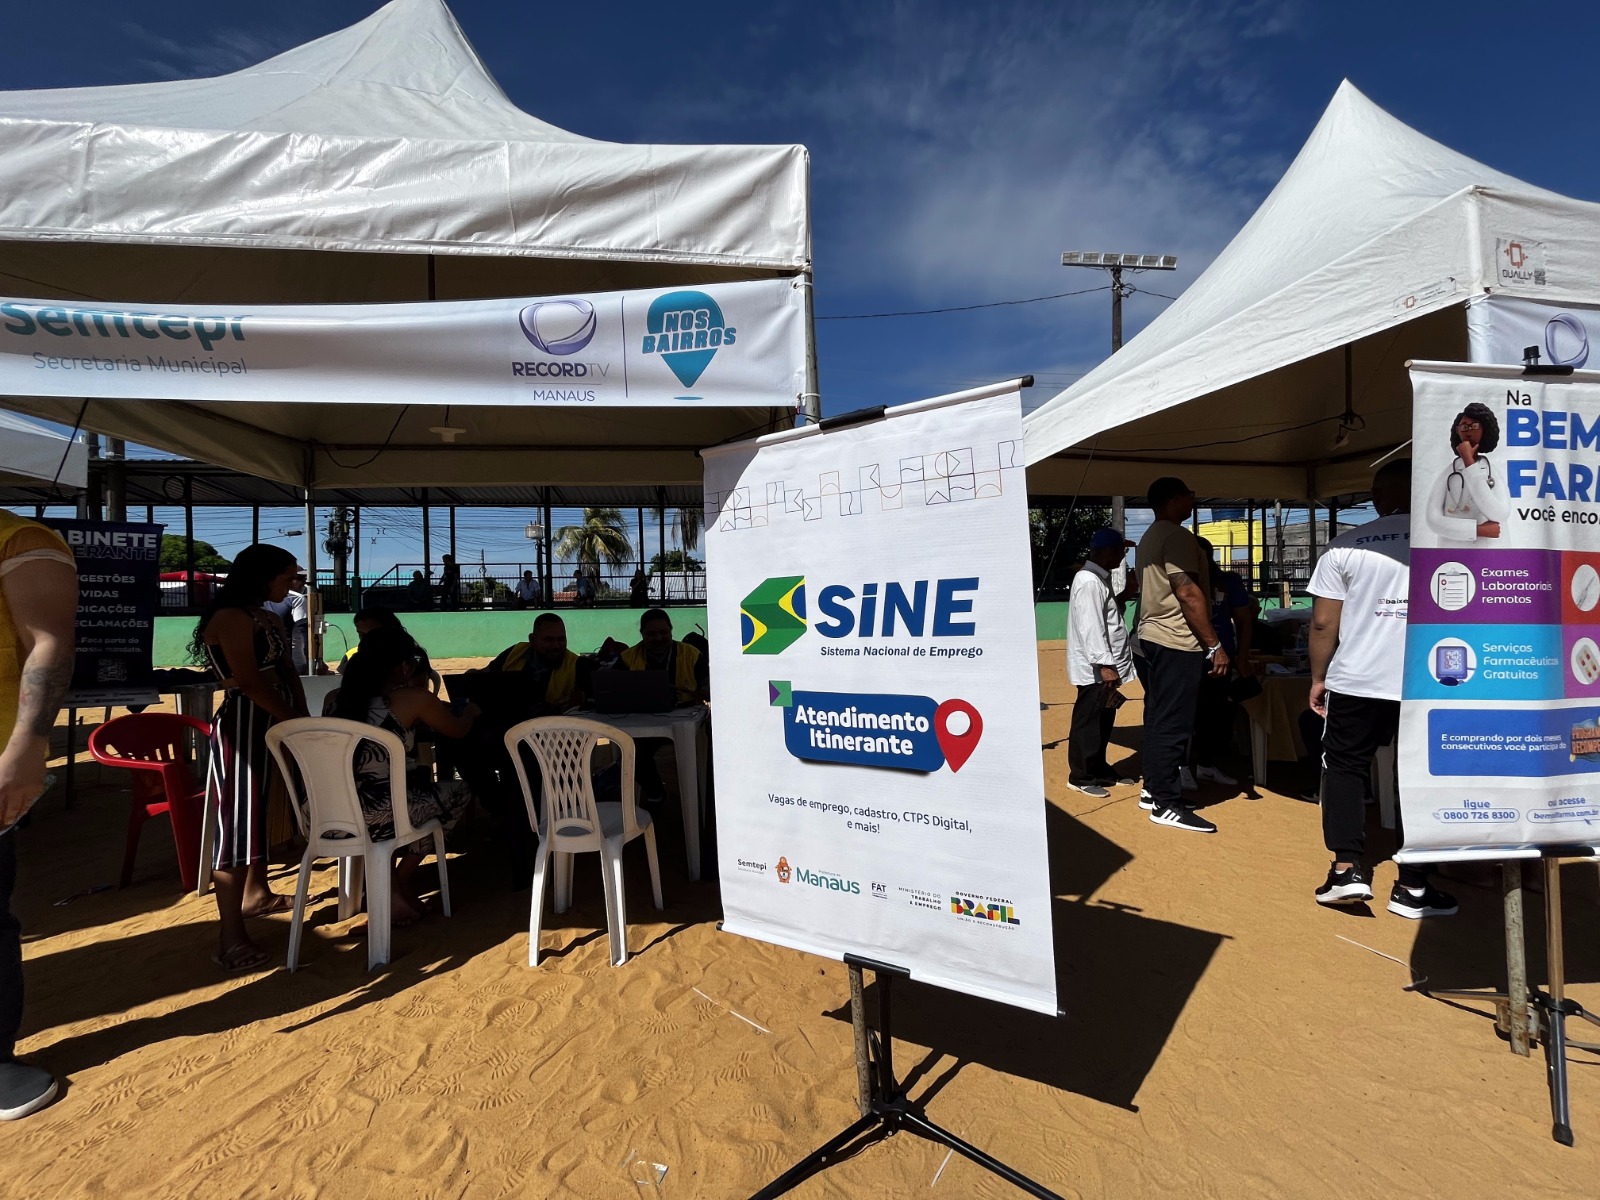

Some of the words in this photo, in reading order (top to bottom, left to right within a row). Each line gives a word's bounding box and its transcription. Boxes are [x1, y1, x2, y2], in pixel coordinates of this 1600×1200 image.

[663, 309, 710, 332] NOS
[642, 327, 737, 355] BAIRROS
[33, 351, 141, 373] Secretaria
[147, 354, 248, 378] Municipal
[533, 389, 596, 402] MANAUS
[1506, 389, 1532, 406] Na
[1506, 460, 1600, 503] FAR
[1517, 505, 1556, 523] você
[1561, 510, 1600, 524] enco
[1355, 533, 1400, 546] STAFF
[78, 573, 136, 584] GESTÕES
[1481, 568, 1529, 578] Exames
[1481, 580, 1552, 591] Laboratoriais
[79, 590, 119, 599] VIDAS
[1481, 595, 1532, 604] remotos
[820, 646, 860, 657] Sistema
[863, 646, 910, 657] Nacional
[912, 646, 926, 657] de
[929, 646, 983, 659] Emprego
[1482, 642, 1533, 655] Serviços
[1483, 656, 1559, 667] Farmacêuticos
[1483, 669, 1539, 680] Gratuitos
[795, 705, 929, 733] Atendimento
[809, 728, 913, 756] Itinerante
[1441, 733, 1447, 741] E
[1449, 734, 1504, 744] comprando
[1506, 735, 1523, 744] por
[1524, 734, 1543, 742] dois
[1441, 742, 1502, 751] consecutivos
[1504, 742, 1526, 751] você
[1528, 743, 1559, 753] participa
[1463, 799, 1491, 809] ligue
[1558, 796, 1586, 806] acesse
[768, 793, 795, 807] Vagas
[797, 796, 808, 807] de
[809, 799, 852, 816] emprego,
[854, 805, 901, 823] cadastro,
[903, 811, 930, 825] CTPS
[932, 815, 973, 833] Digital,
[1444, 811, 1469, 820] 0800
[1471, 811, 1489, 820] 726
[1491, 810, 1516, 820] 8300
[847, 820, 853, 829] e
[854, 819, 881, 834] mais!
[737, 858, 767, 871] Semtepi
[796, 866, 861, 895] Manaus
[871, 882, 887, 893] FAT
[911, 894, 942, 905] TRABALHO
[955, 891, 984, 900] GOVERNO
[985, 896, 1014, 905] FEDERAL
[951, 896, 1021, 926] BRASIL
